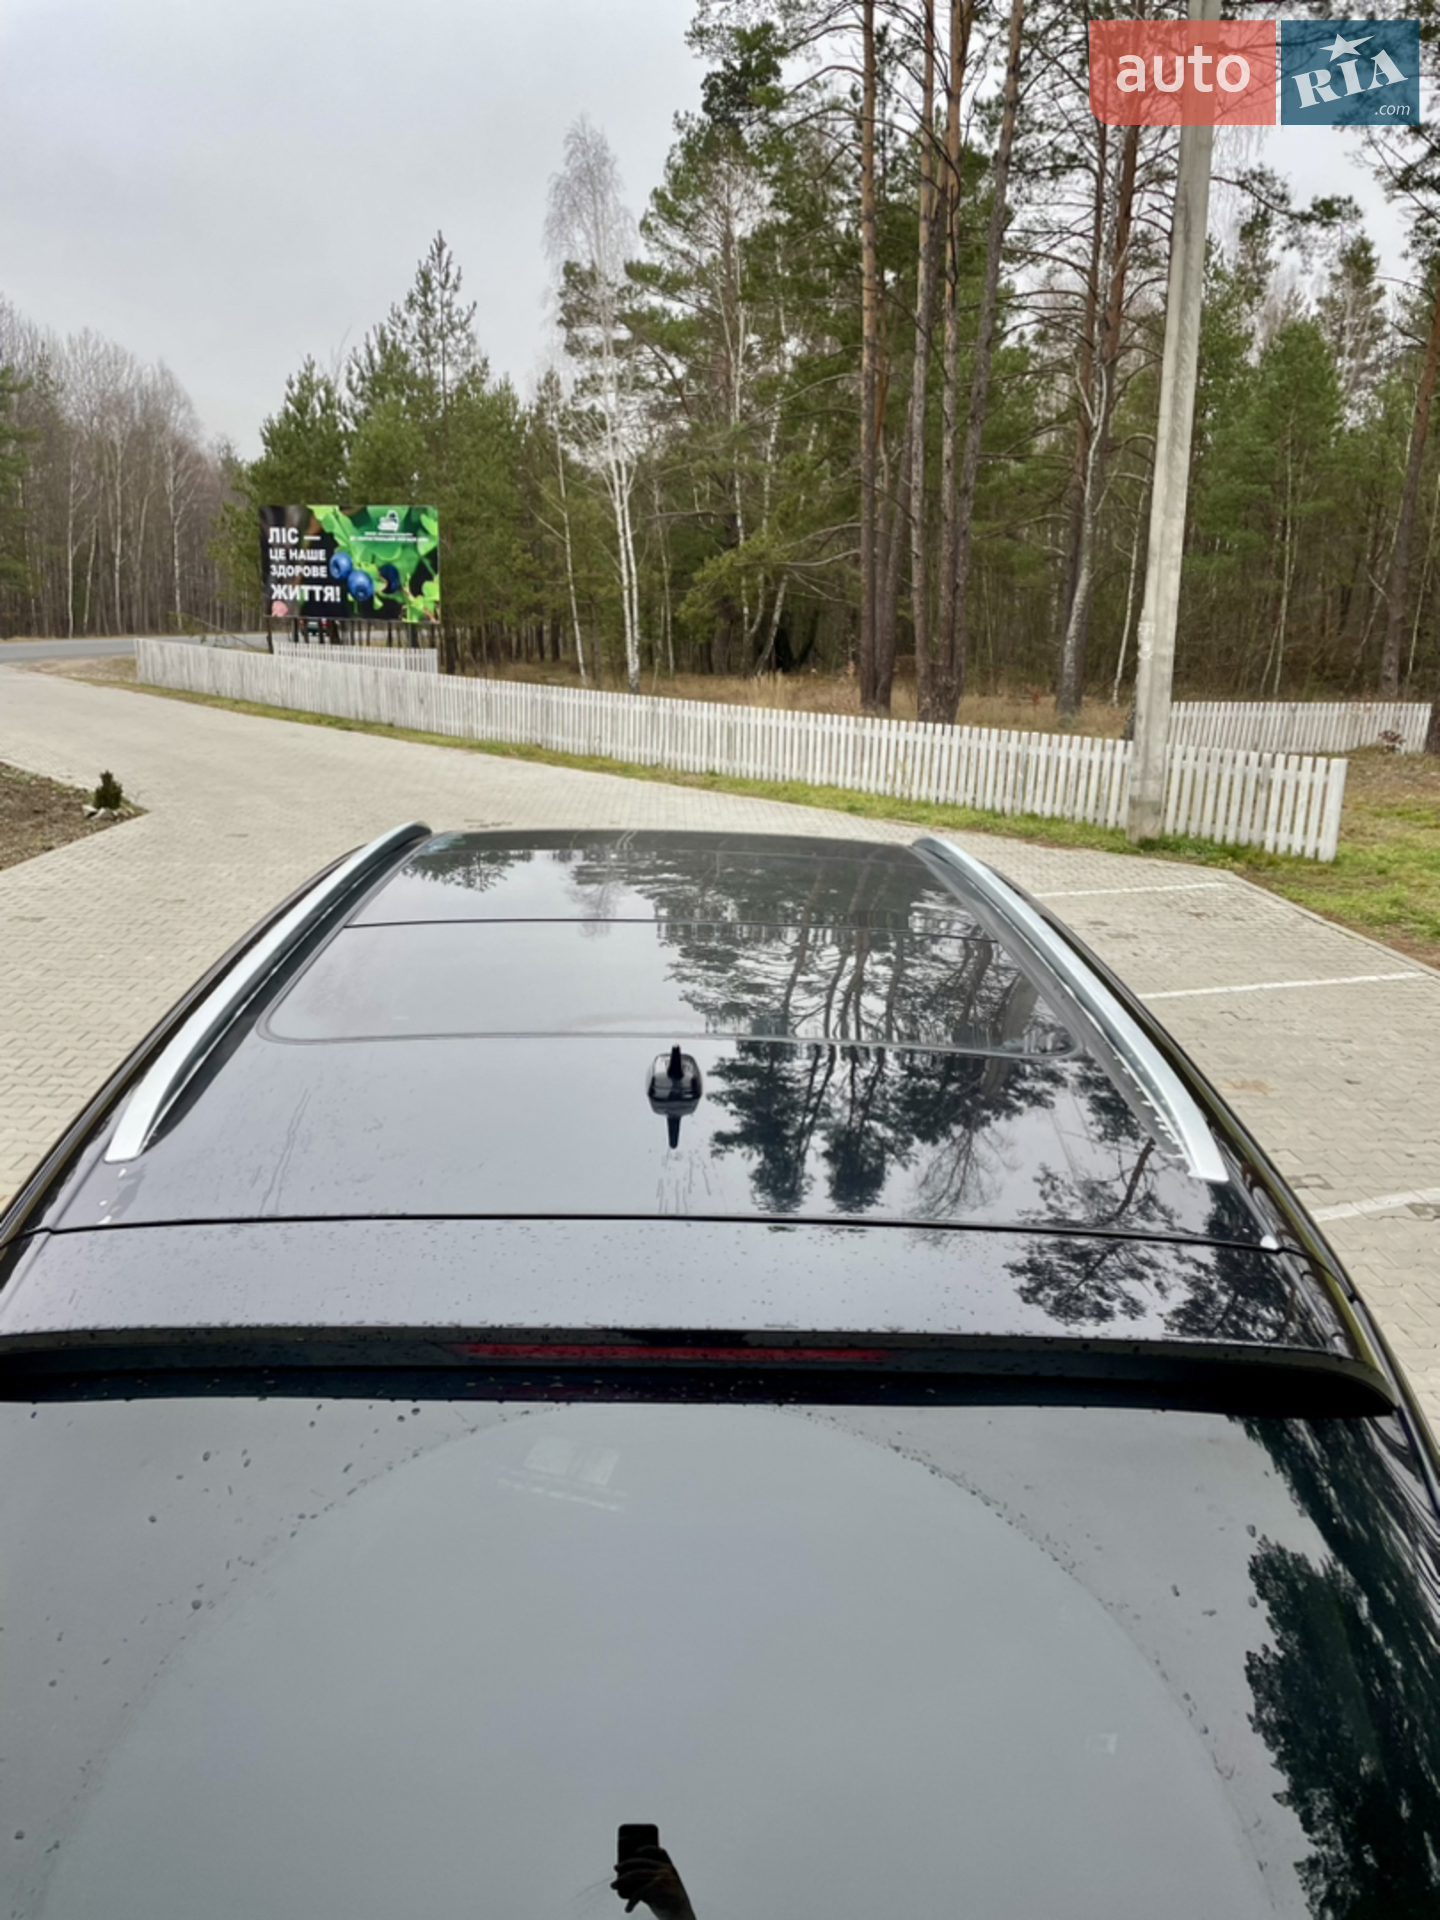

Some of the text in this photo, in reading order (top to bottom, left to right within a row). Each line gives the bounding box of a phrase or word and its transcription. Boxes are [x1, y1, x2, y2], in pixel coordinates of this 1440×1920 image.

[268, 527, 300, 544] ЛІС
[269, 548, 326, 562] ЦЕ НАШЕ
[270, 564, 328, 578] ЗДОРОВЕ
[270, 583, 341, 603] ЖИТТЯ!
